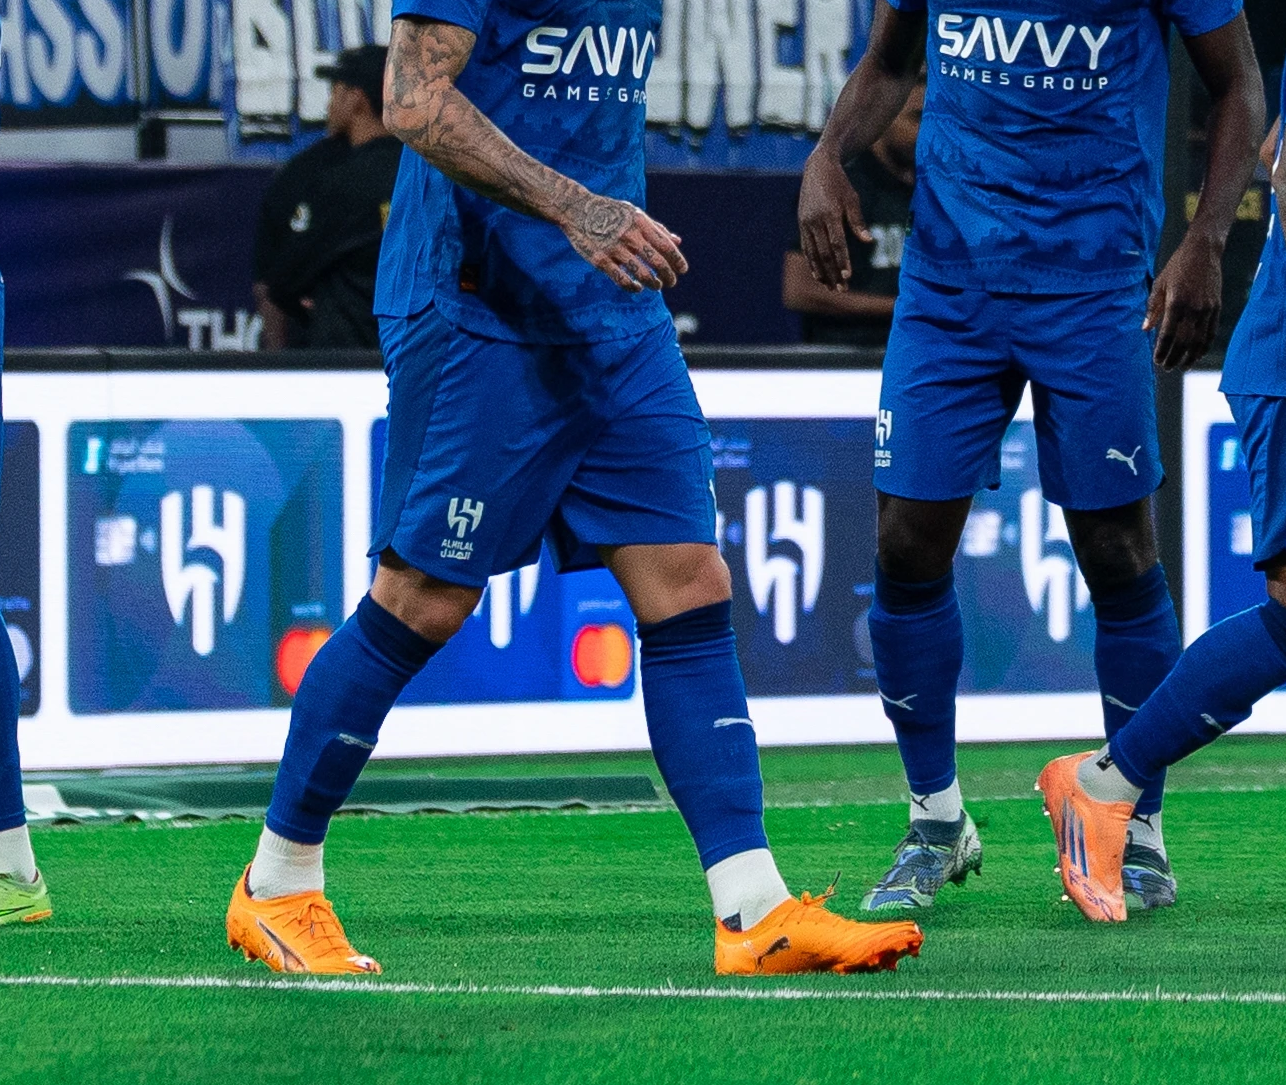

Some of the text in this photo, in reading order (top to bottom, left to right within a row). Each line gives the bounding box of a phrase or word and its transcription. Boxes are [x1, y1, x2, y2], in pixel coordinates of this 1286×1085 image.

[521, 25, 656, 79] SAVV
[937, 13, 1113, 71] SAVVY
[940, 62, 1109, 91] GAMES GROUP
[523, 84, 611, 102] GAMES
[440, 548, 471, 561] الهلال
[441, 538, 474, 552] ALHILAL
